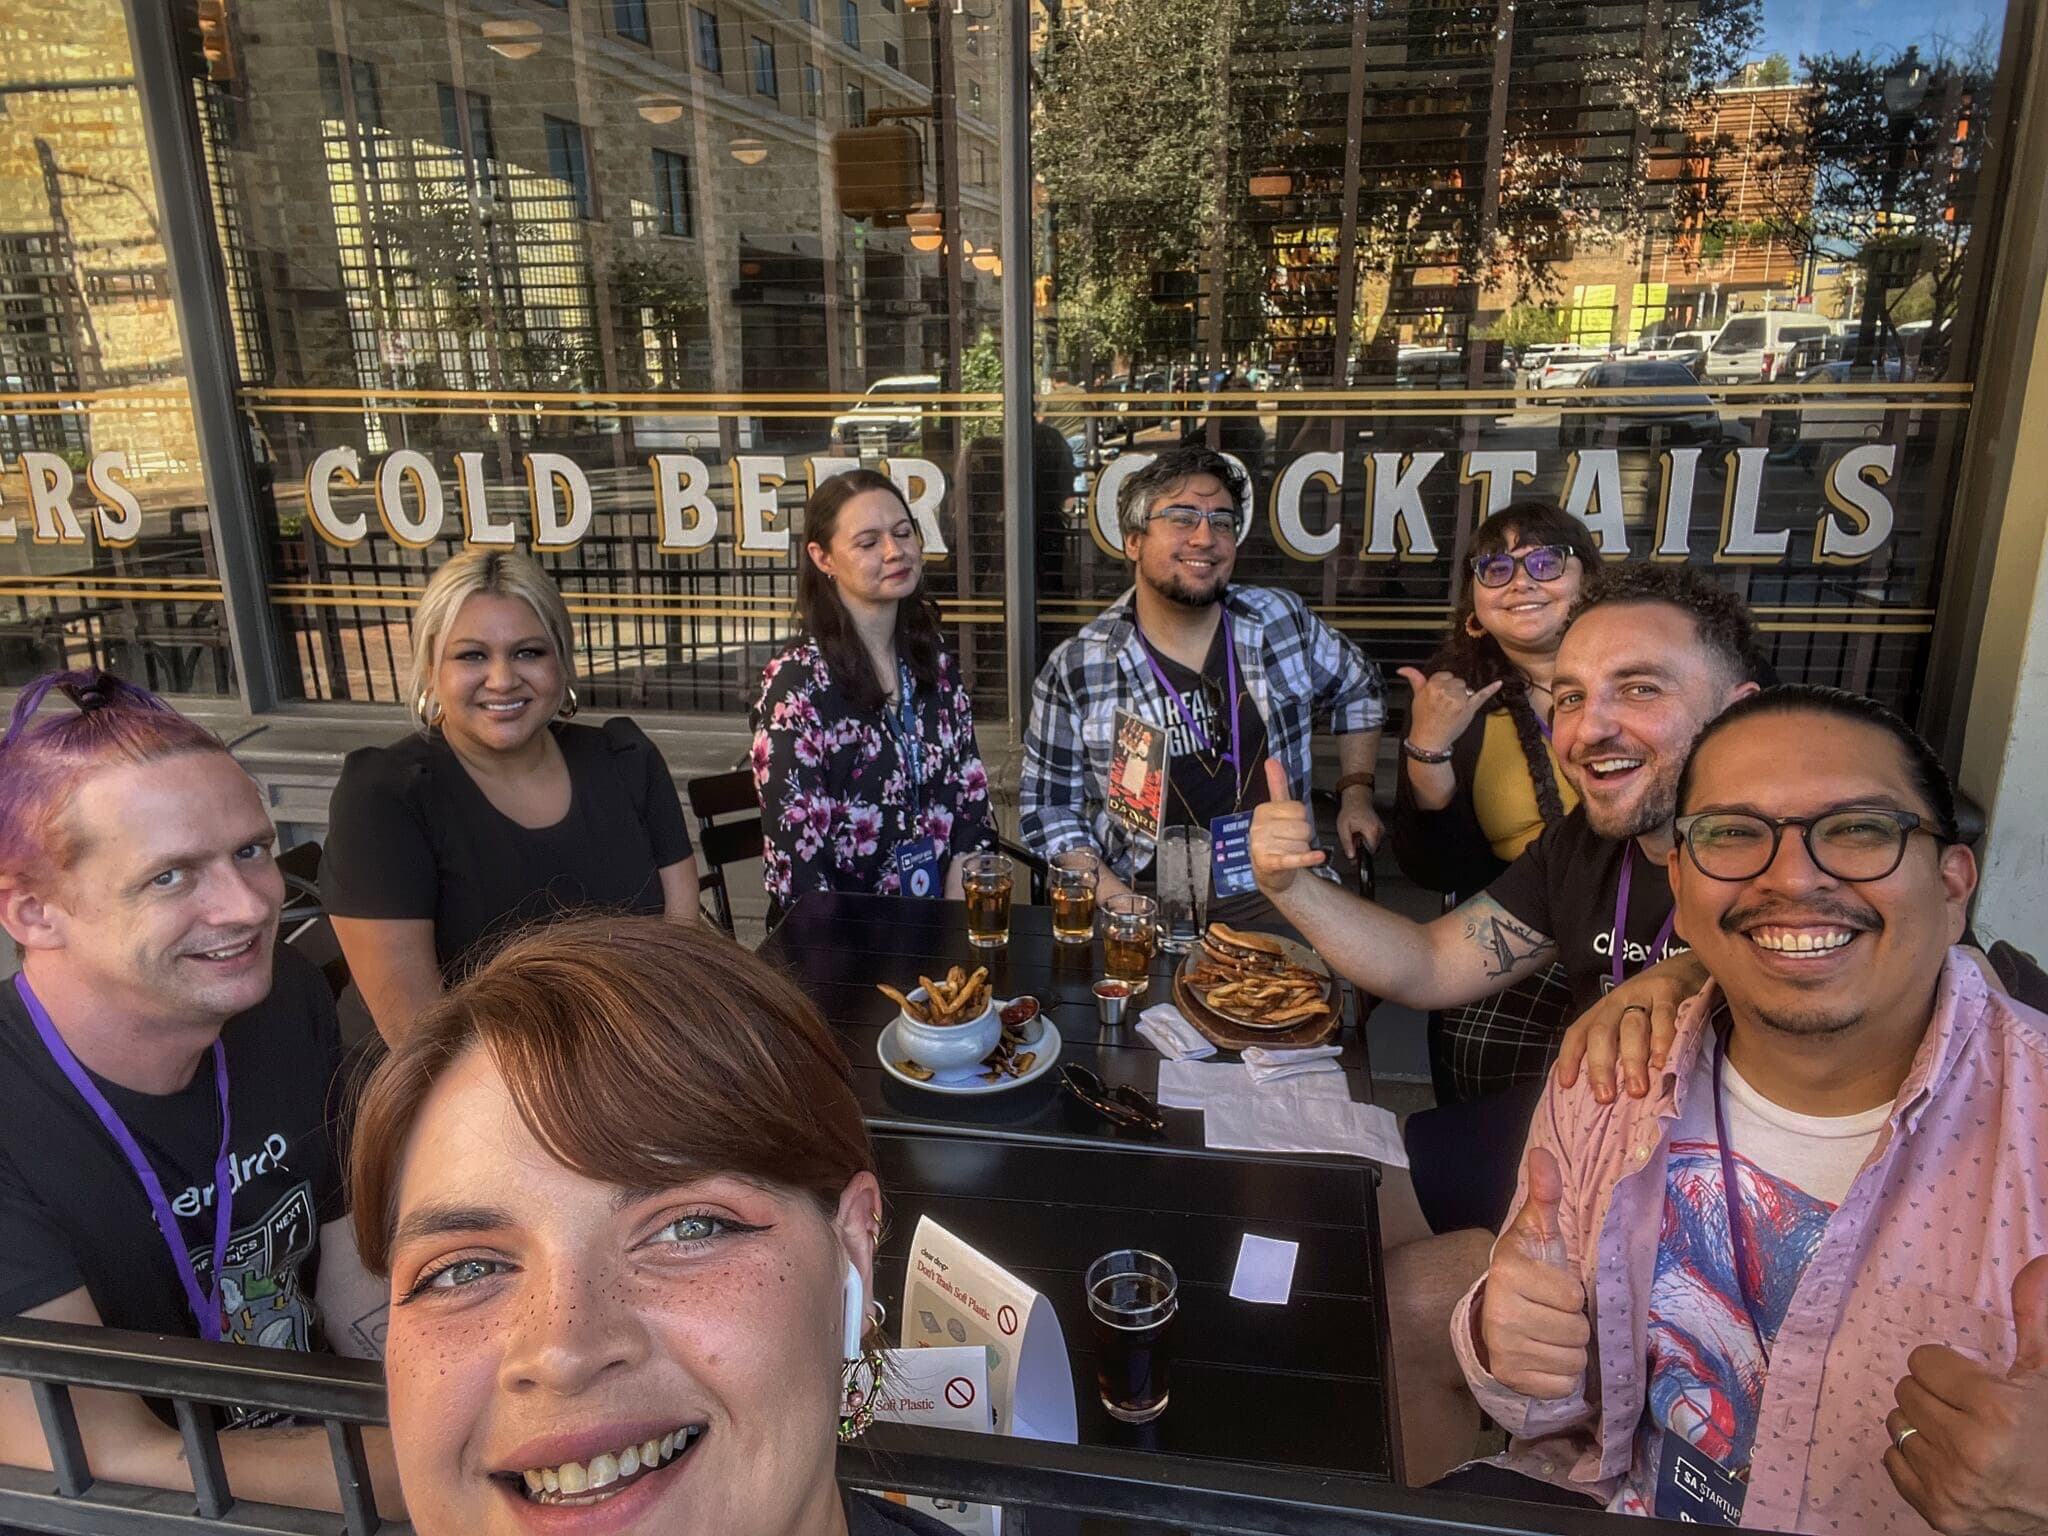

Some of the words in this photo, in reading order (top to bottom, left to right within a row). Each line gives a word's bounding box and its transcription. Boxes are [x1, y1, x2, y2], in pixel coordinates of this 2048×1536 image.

[304, 447, 593, 552] COLD
[648, 454, 949, 562] BER
[275, 1201, 301, 1234] NEXT
[916, 1259, 935, 1281] Don't
[935, 1273, 953, 1294] Trash
[953, 1286, 968, 1305] Soft
[968, 1296, 991, 1321] Plastic
[875, 1399, 897, 1412] Soft
[900, 1398, 935, 1411] Plastic
[1683, 1471, 1697, 1489] SA
[1699, 1484, 1741, 1519] STARTUP
